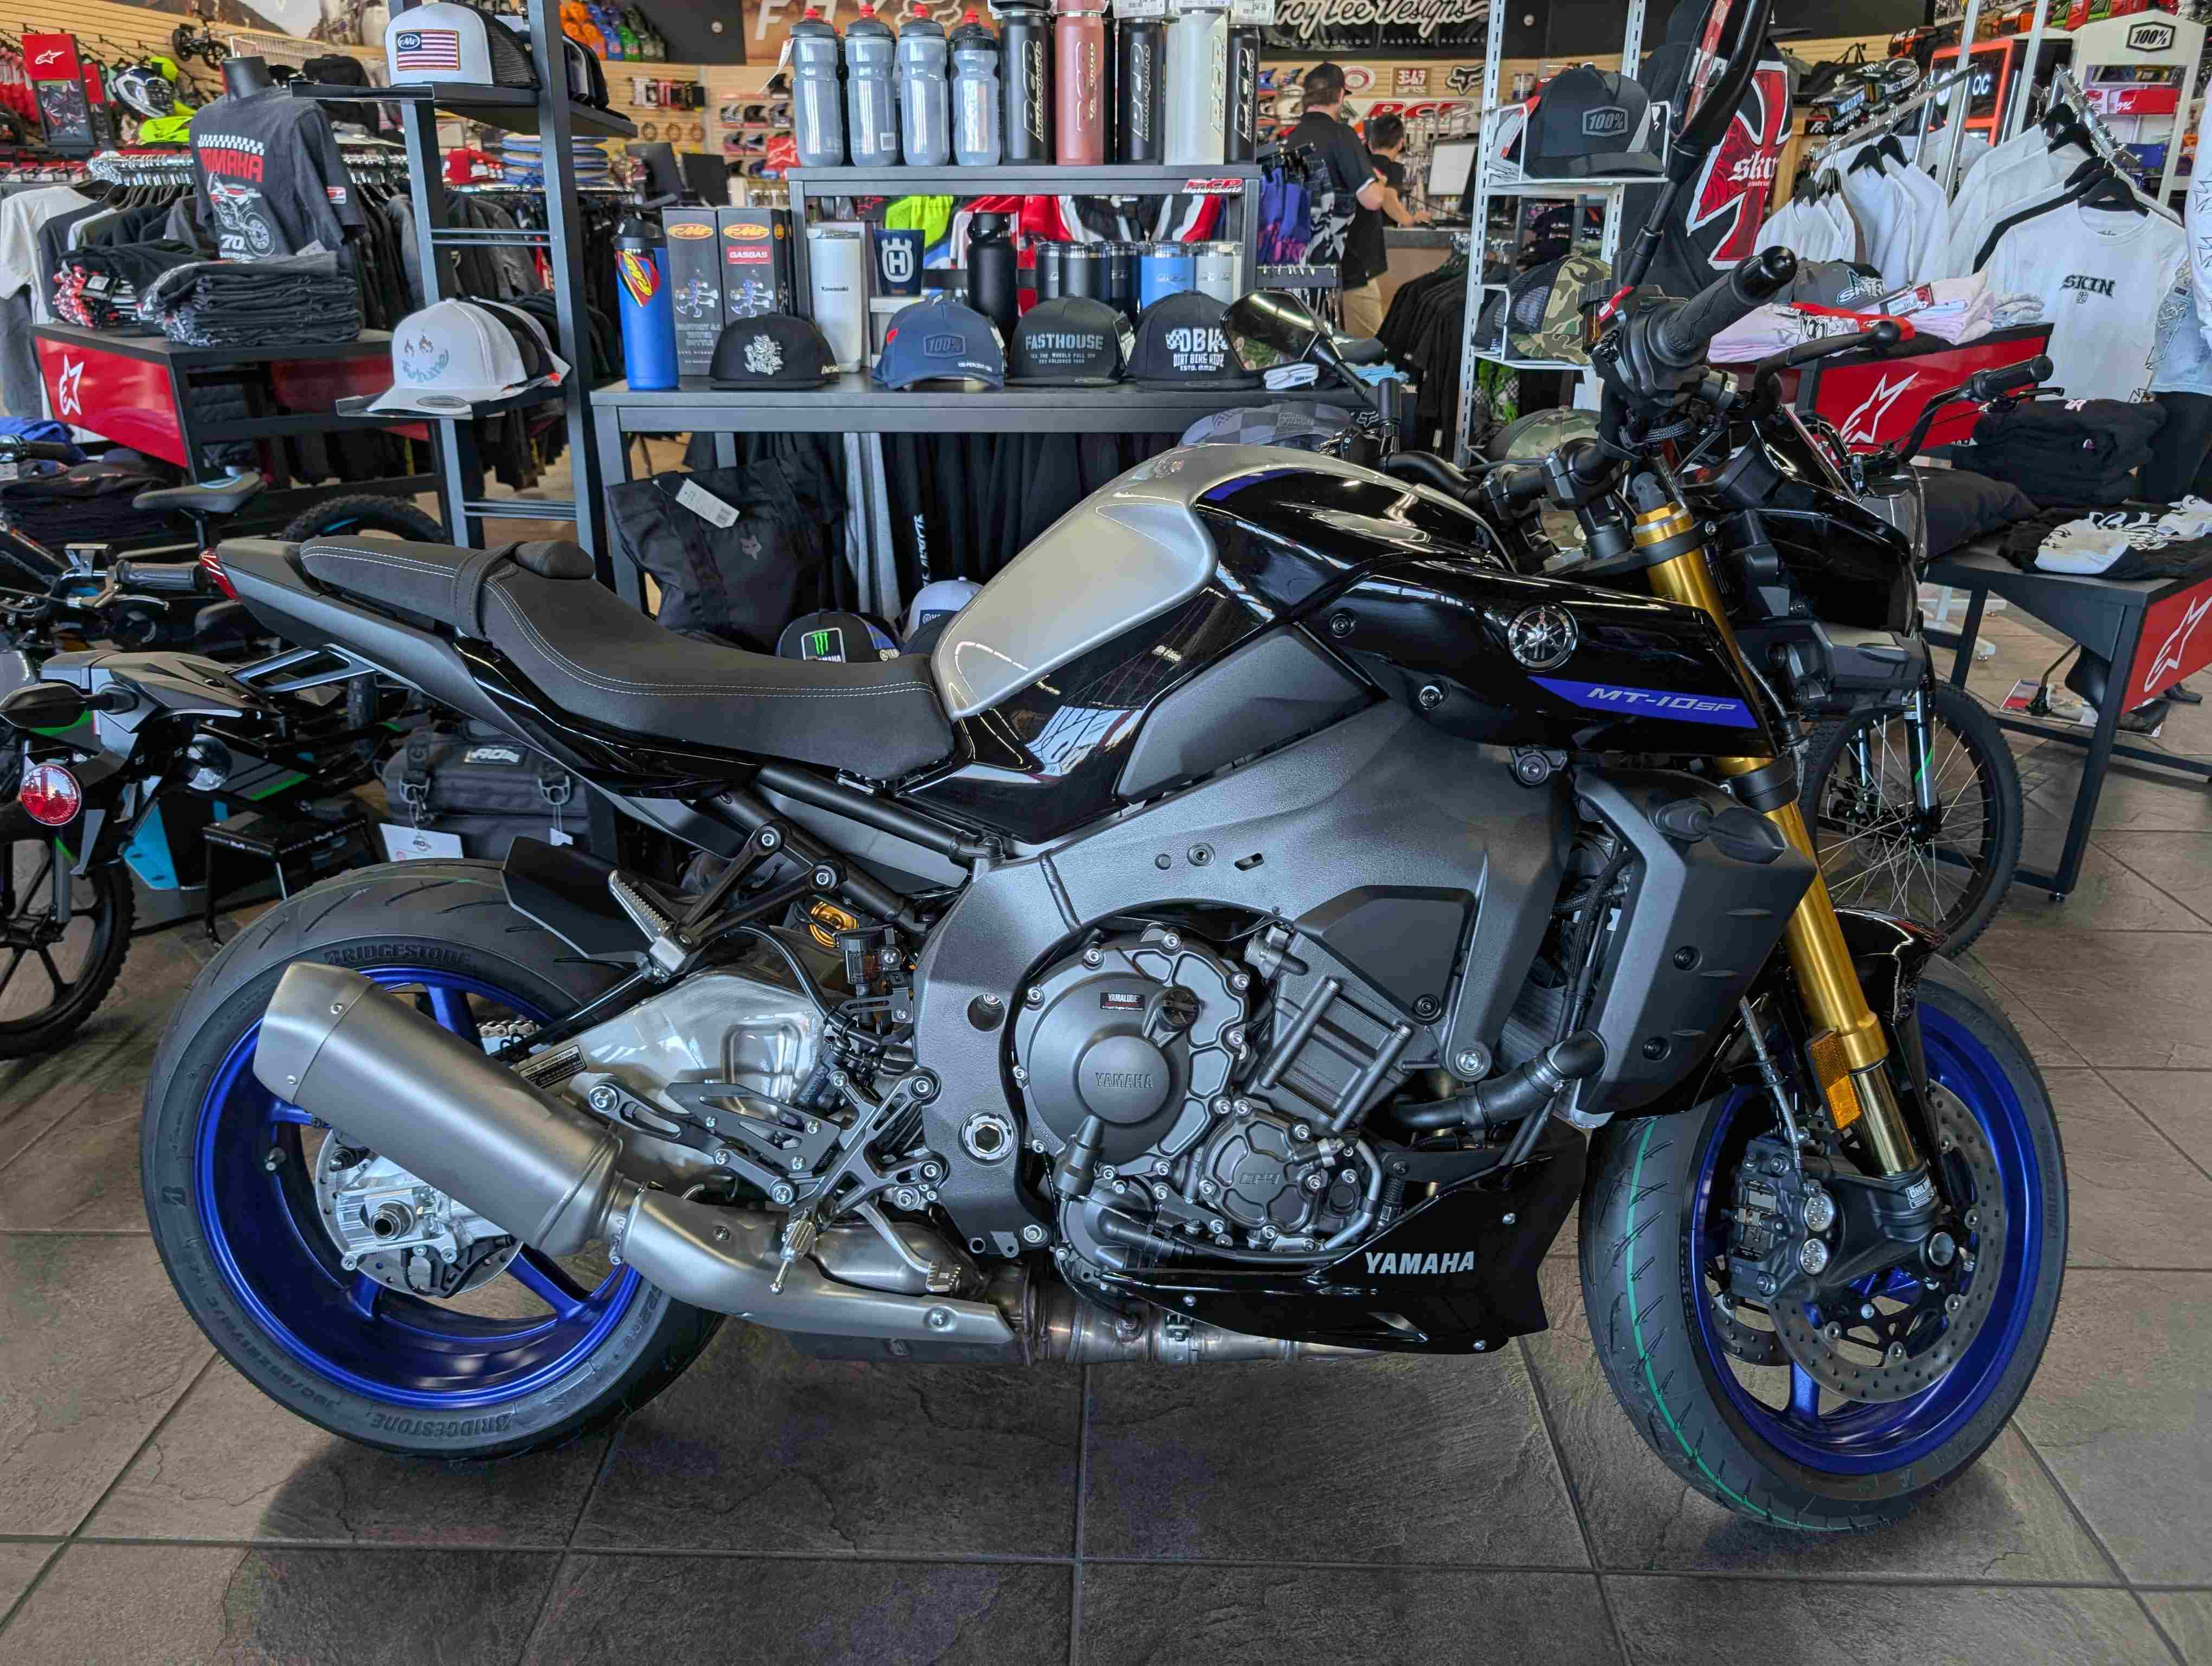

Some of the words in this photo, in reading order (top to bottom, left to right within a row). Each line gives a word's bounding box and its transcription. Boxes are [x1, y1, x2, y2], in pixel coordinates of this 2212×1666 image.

[2133, 29, 2169, 44] 100%
[1589, 113, 1624, 131] 100%
[929, 338, 961, 353] 100%
[1025, 333, 1104, 351] FASTHOUSE
[1189, 354, 1208, 364] BIKE
[1108, 993, 1139, 1003] YAMALUBE
[1095, 1072, 1154, 1088] YAMAHA
[1365, 1251, 1475, 1274] YAMAHA
[371, 1414, 514, 1437] BRIDGESTONE
